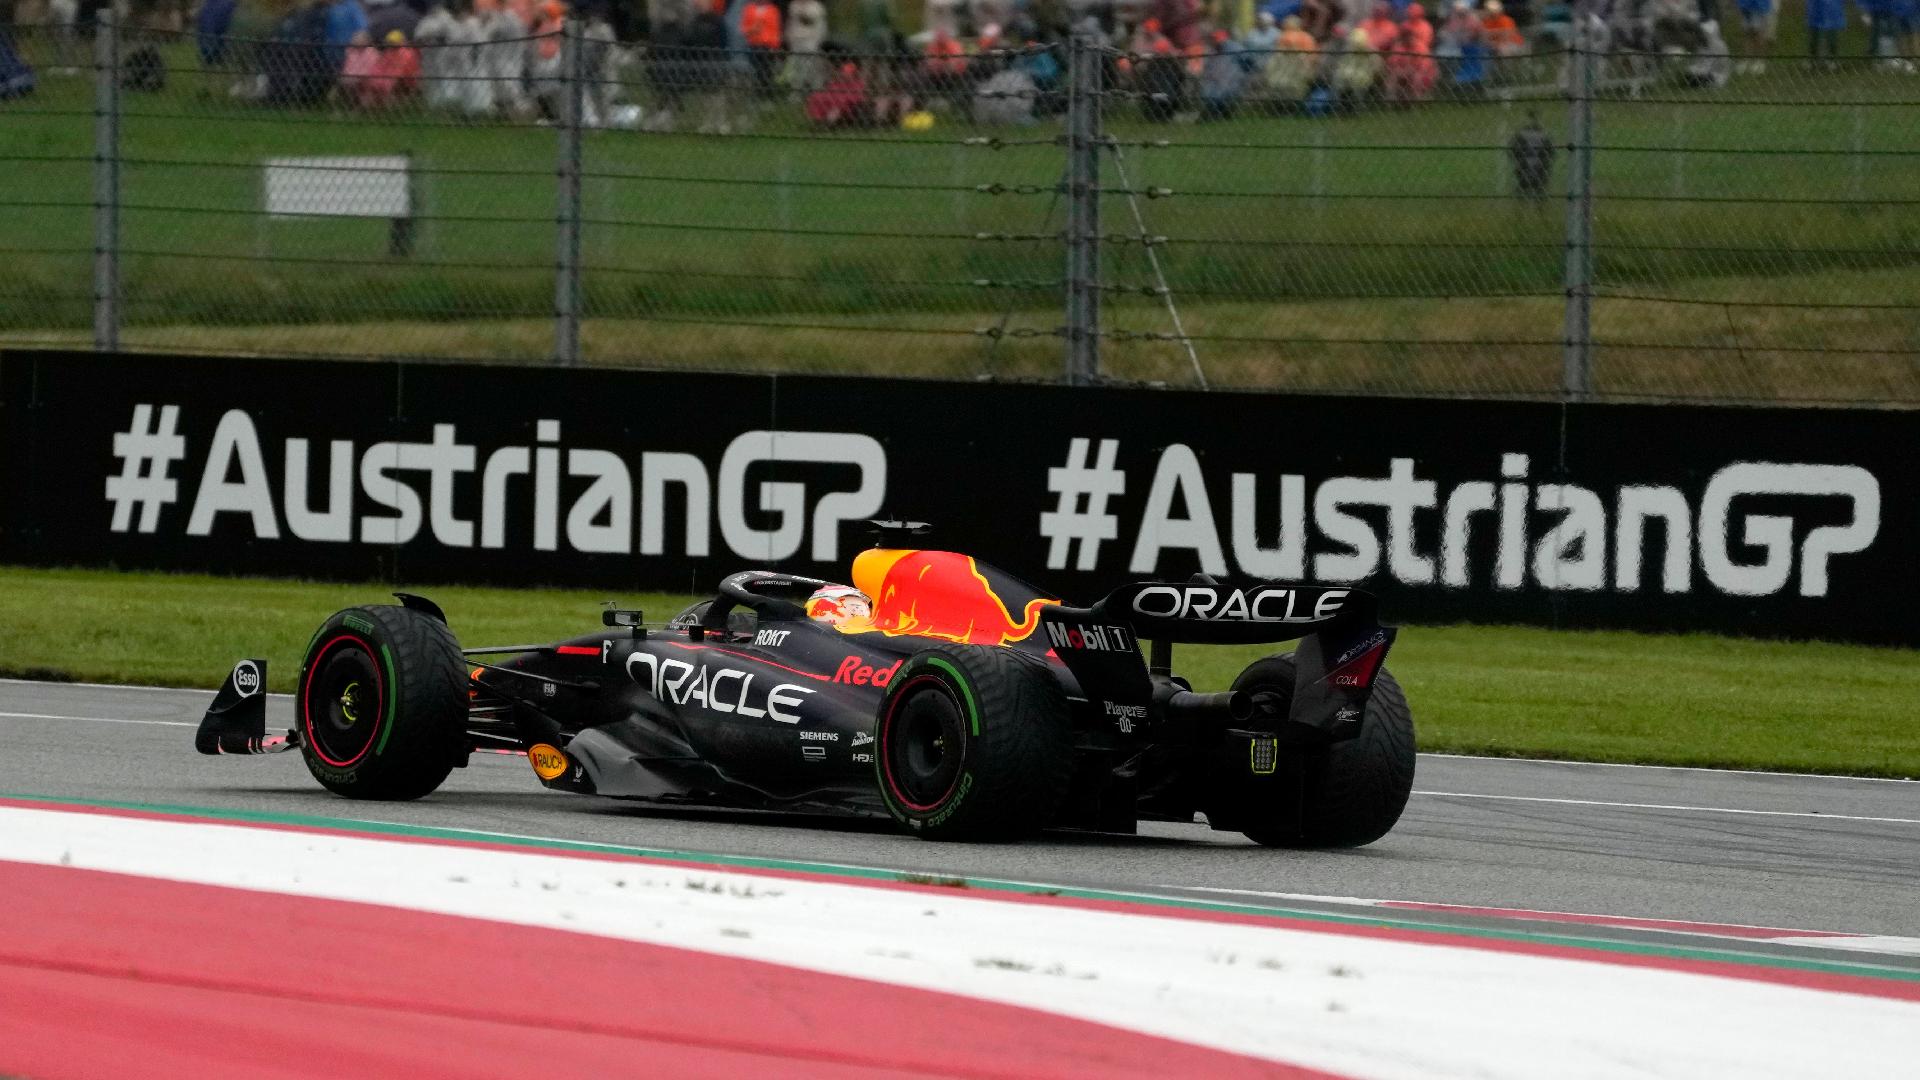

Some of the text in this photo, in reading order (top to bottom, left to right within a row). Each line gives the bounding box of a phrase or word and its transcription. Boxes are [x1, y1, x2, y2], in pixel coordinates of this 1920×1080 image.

[105, 404, 887, 562] #AustrianGP
[1039, 437, 1881, 597] #AustrianGP
[1133, 586, 1351, 621] ORACLE
[755, 629, 791, 647] ROKT
[1046, 621, 1111, 651] Mobil
[626, 651, 817, 725] ORACLE
[832, 655, 904, 688] Red
[800, 731, 839, 742] SIEMENS
[538, 753, 563, 770] RAUCH
